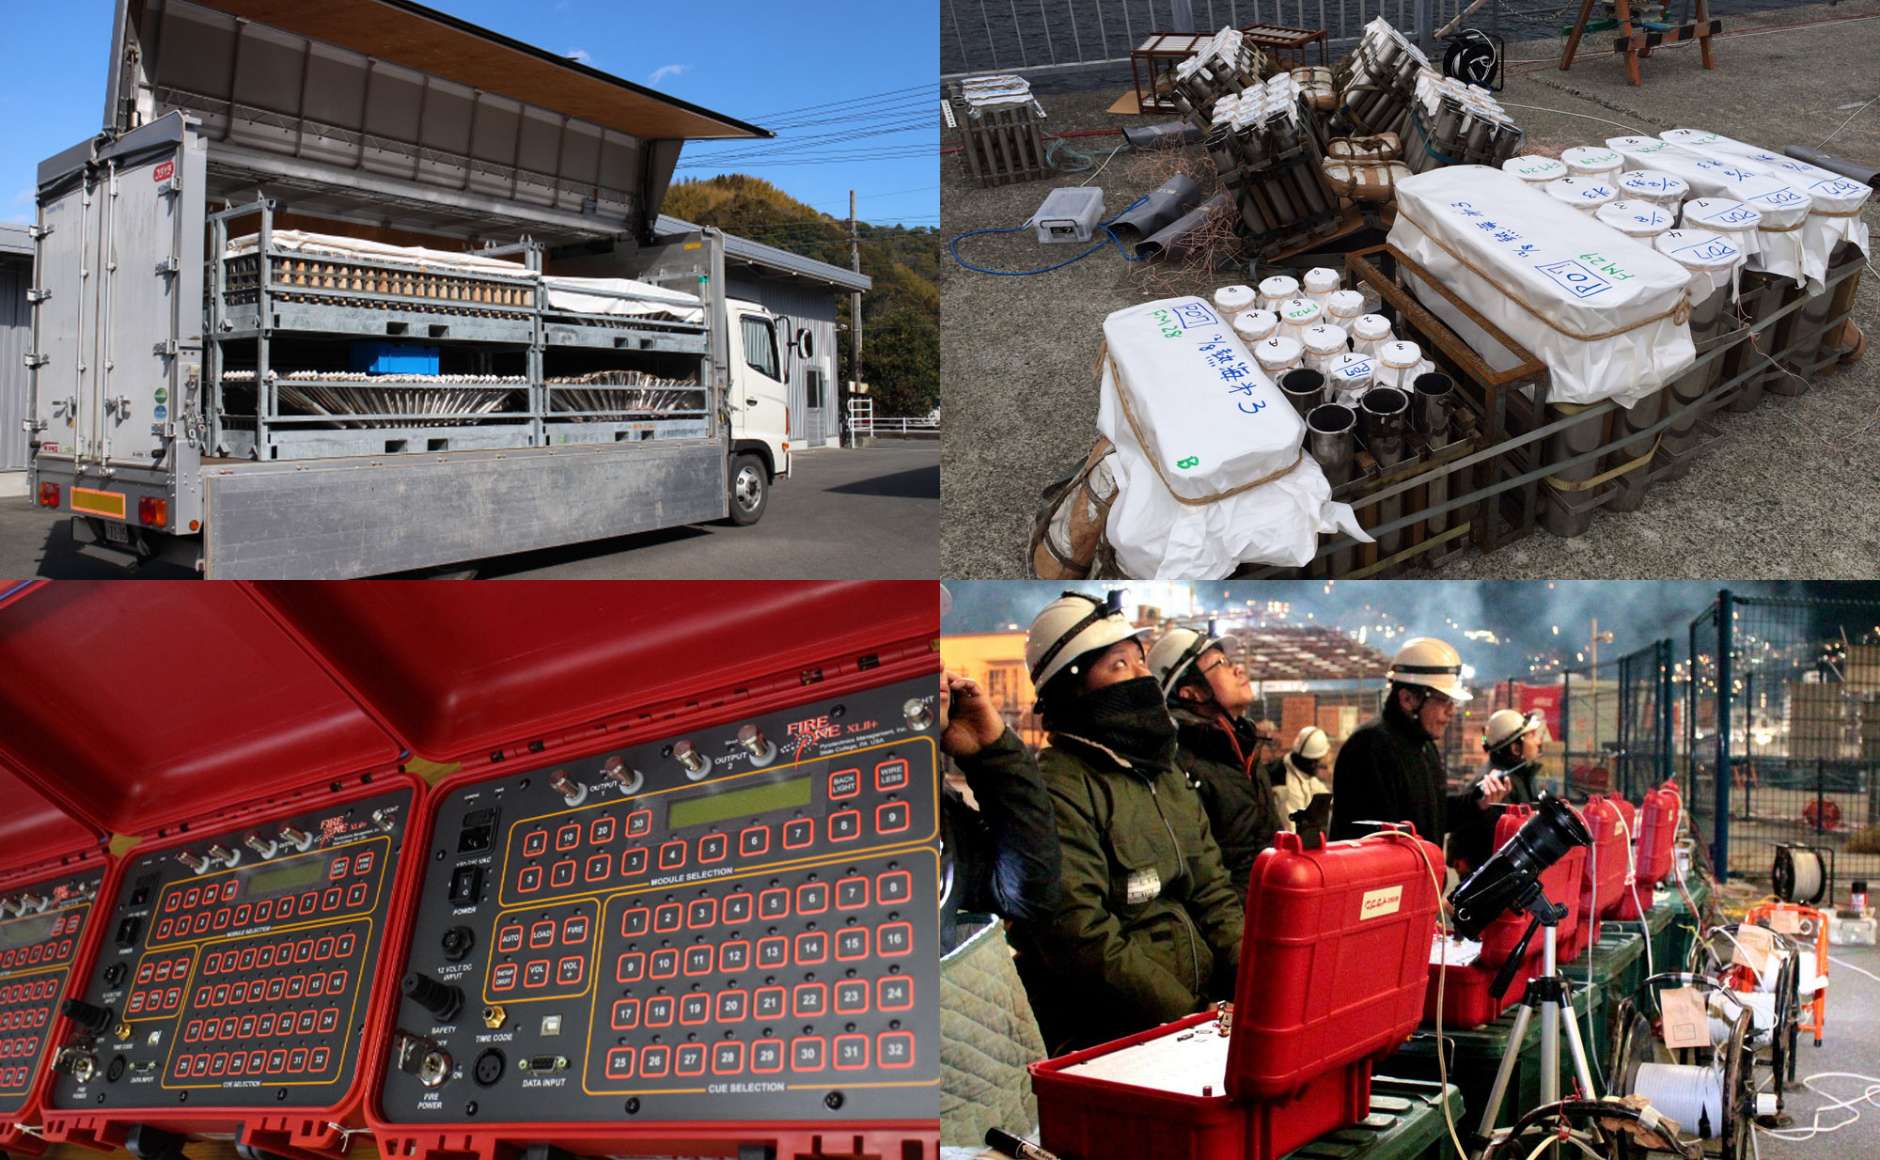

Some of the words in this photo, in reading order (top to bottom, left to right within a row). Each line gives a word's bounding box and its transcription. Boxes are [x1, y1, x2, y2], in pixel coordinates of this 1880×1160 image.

[1176, 456, 1200, 470] B
[786, 715, 830, 736] FIRE
[714, 752, 748, 766] OUTPUT
[833, 775, 855, 786] BACK
[833, 783, 856, 794] LIGHT
[597, 825, 609, 836] 20
[594, 863, 602, 873] 2
[631, 857, 639, 866] 3
[669, 850, 677, 859] 4
[709, 843, 717, 853] 5
[751, 836, 759, 846] 6
[794, 828, 802, 838] 7
[840, 821, 848, 831] 8
[888, 812, 897, 823] 9
[650, 871, 685, 887] MODULE
[685, 866, 734, 881] SELECTION
[664, 913, 672, 923] 2
[698, 908, 706, 918] 3
[733, 903, 741, 913] 4
[770, 898, 778, 908] 5
[808, 893, 816, 904] 6
[849, 888, 856, 898] 7
[889, 882, 898, 893] 8
[502, 934, 520, 943] AUTO
[533, 929, 551, 939] LOAD
[567, 925, 584, 935] FIRE
[627, 962, 634, 972] 9
[658, 958, 670, 969] 10
[693, 955, 705, 965] 11
[728, 951, 742, 961] 12
[766, 946, 779, 957] 13
[804, 943, 818, 953] 14
[845, 938, 859, 948] 15
[887, 933, 902, 945] 16
[529, 966, 545, 974] VOL
[563, 962, 579, 970] VOL
[620, 1009, 632, 1019] 17
[653, 1006, 665, 1016] 18
[688, 1003, 701, 1014] 19
[724, 1000, 738, 1011] 20
[763, 998, 776, 1008] 21
[802, 994, 817, 1006] 22
[844, 990, 859, 1002] 23
[887, 987, 902, 999] 24
[431, 1025, 457, 1035] SAFETY
[475, 1033, 493, 1043] TIME
[493, 1033, 513, 1042] CODE
[614, 1057, 627, 1068] 25
[648, 1055, 661, 1067] 26
[684, 1053, 697, 1065] 27
[721, 1051, 735, 1063] 28
[760, 1050, 774, 1061] 29
[800, 1048, 815, 1059] 30
[844, 1046, 858, 1057] 31
[888, 1043, 903, 1056] 32
[522, 1079, 542, 1088] DATA
[542, 1077, 567, 1088] INPUT
[708, 1082, 728, 1094] CUE
[729, 1081, 785, 1093] SELECTION
[417, 1101, 443, 1110] POWER
